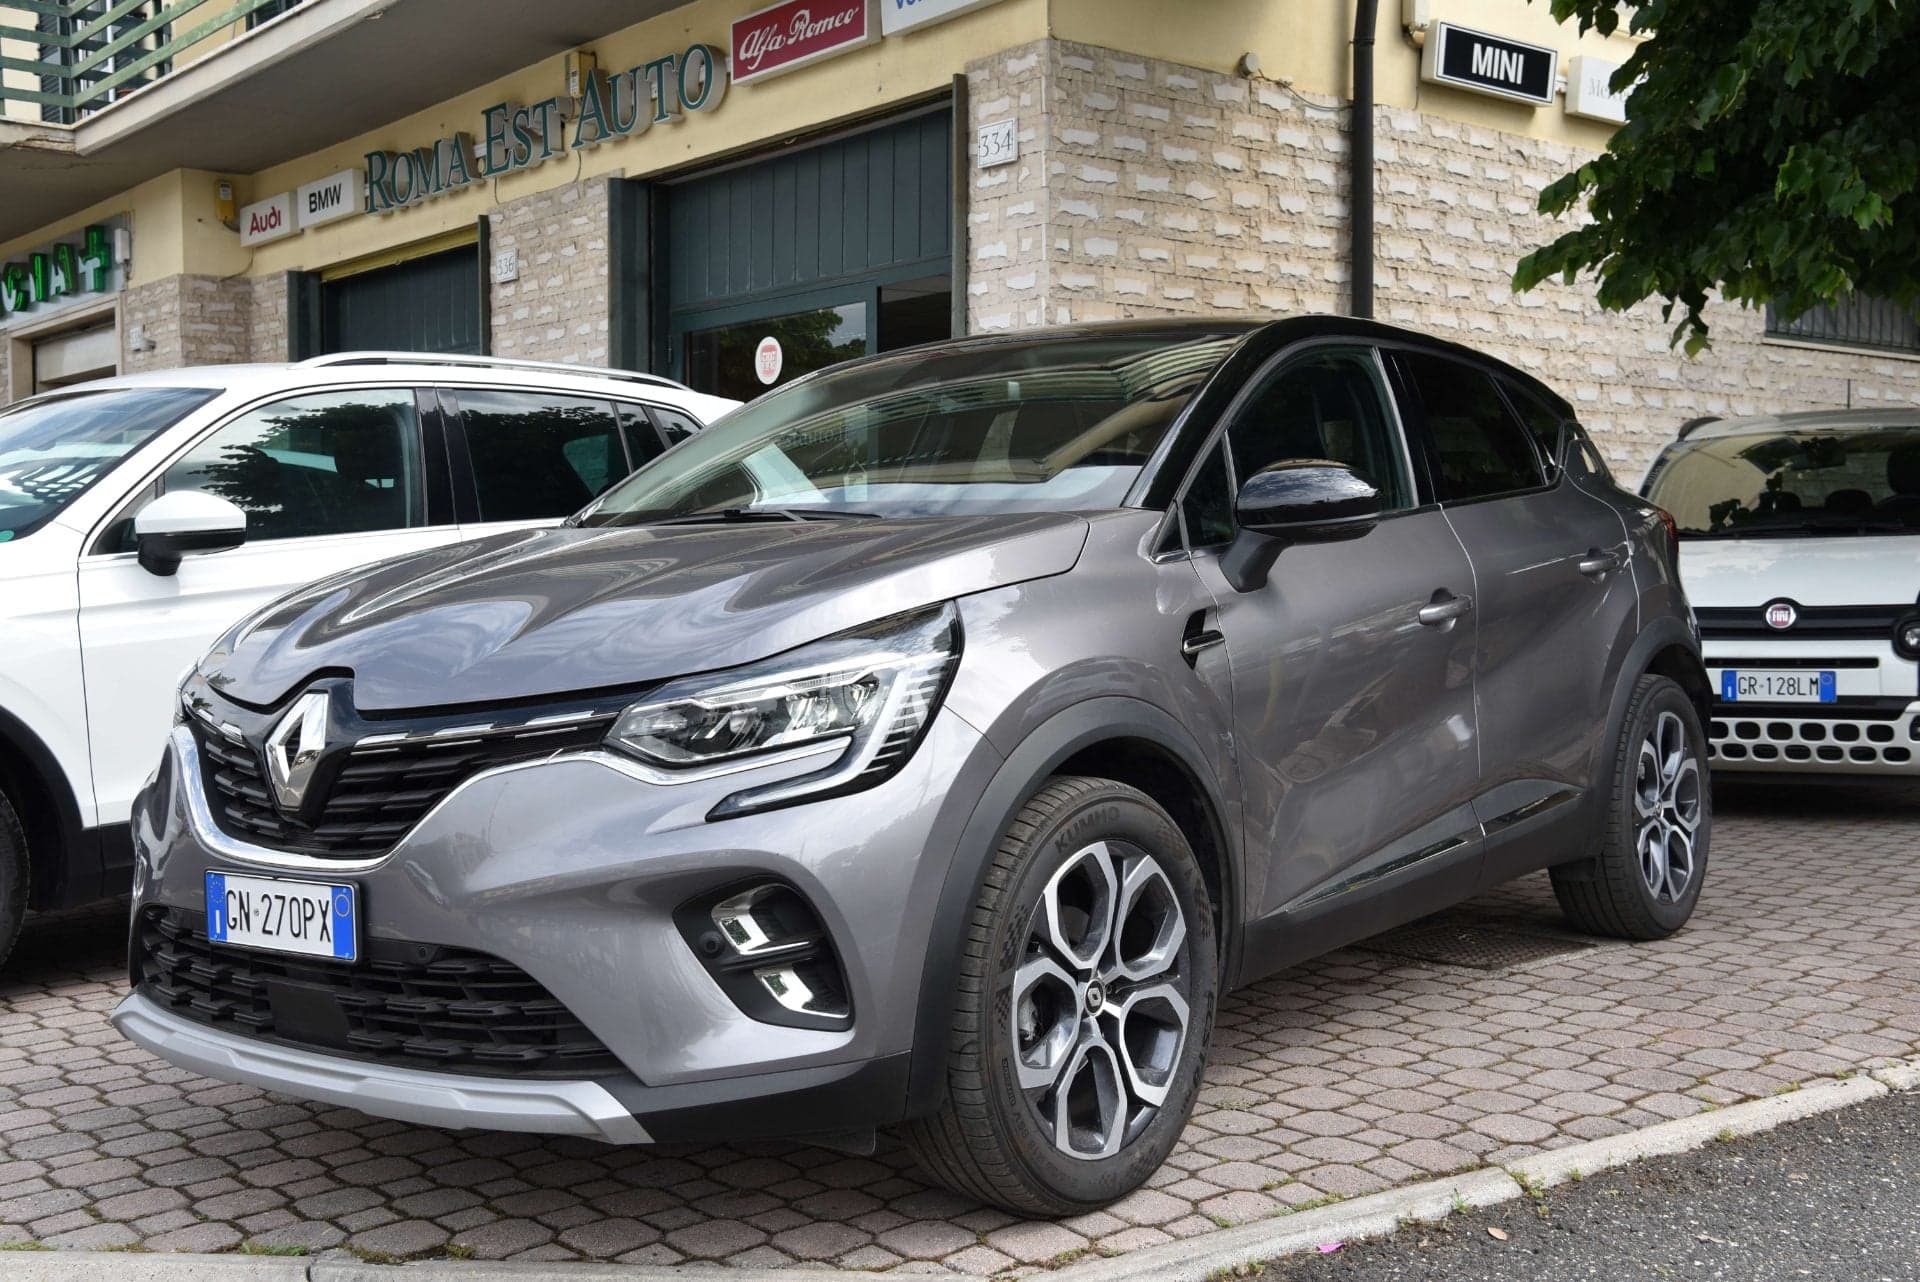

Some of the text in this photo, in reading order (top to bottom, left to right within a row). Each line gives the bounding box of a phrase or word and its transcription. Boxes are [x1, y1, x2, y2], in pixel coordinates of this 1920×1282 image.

[739, 6, 859, 70] Alfa Romeo
[1471, 43, 1524, 85] MINI
[364, 131, 472, 214] ROMA
[572, 43, 714, 149] AUTO
[980, 129, 1013, 158] 334
[308, 183, 343, 214] BMW
[249, 206, 281, 236] Audi
[1772, 610, 1790, 623] FIAT
